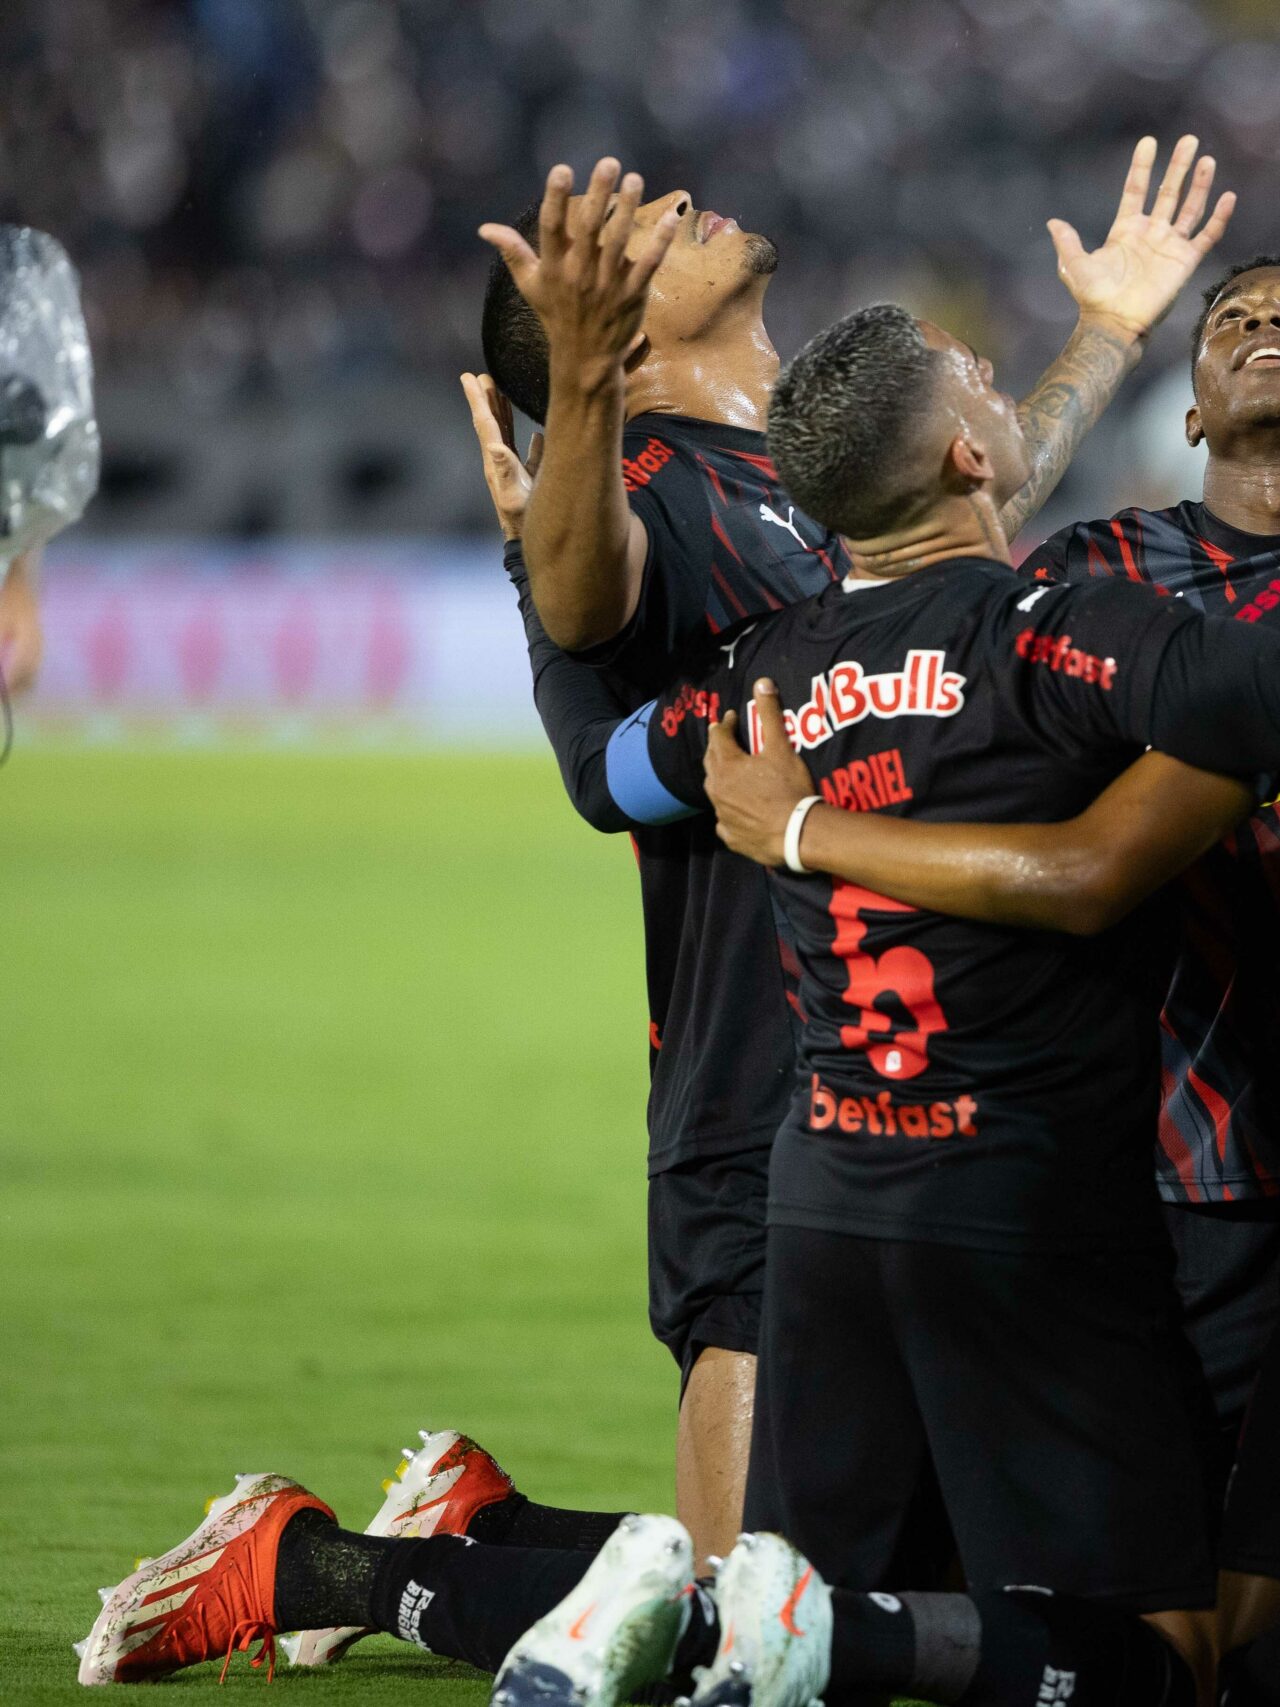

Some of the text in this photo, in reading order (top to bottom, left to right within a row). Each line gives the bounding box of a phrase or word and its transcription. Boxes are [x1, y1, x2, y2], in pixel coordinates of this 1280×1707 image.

[828, 650, 967, 731] Bulls
[820, 749, 914, 813] ABRIEL
[809, 1073, 978, 1138] betfast
